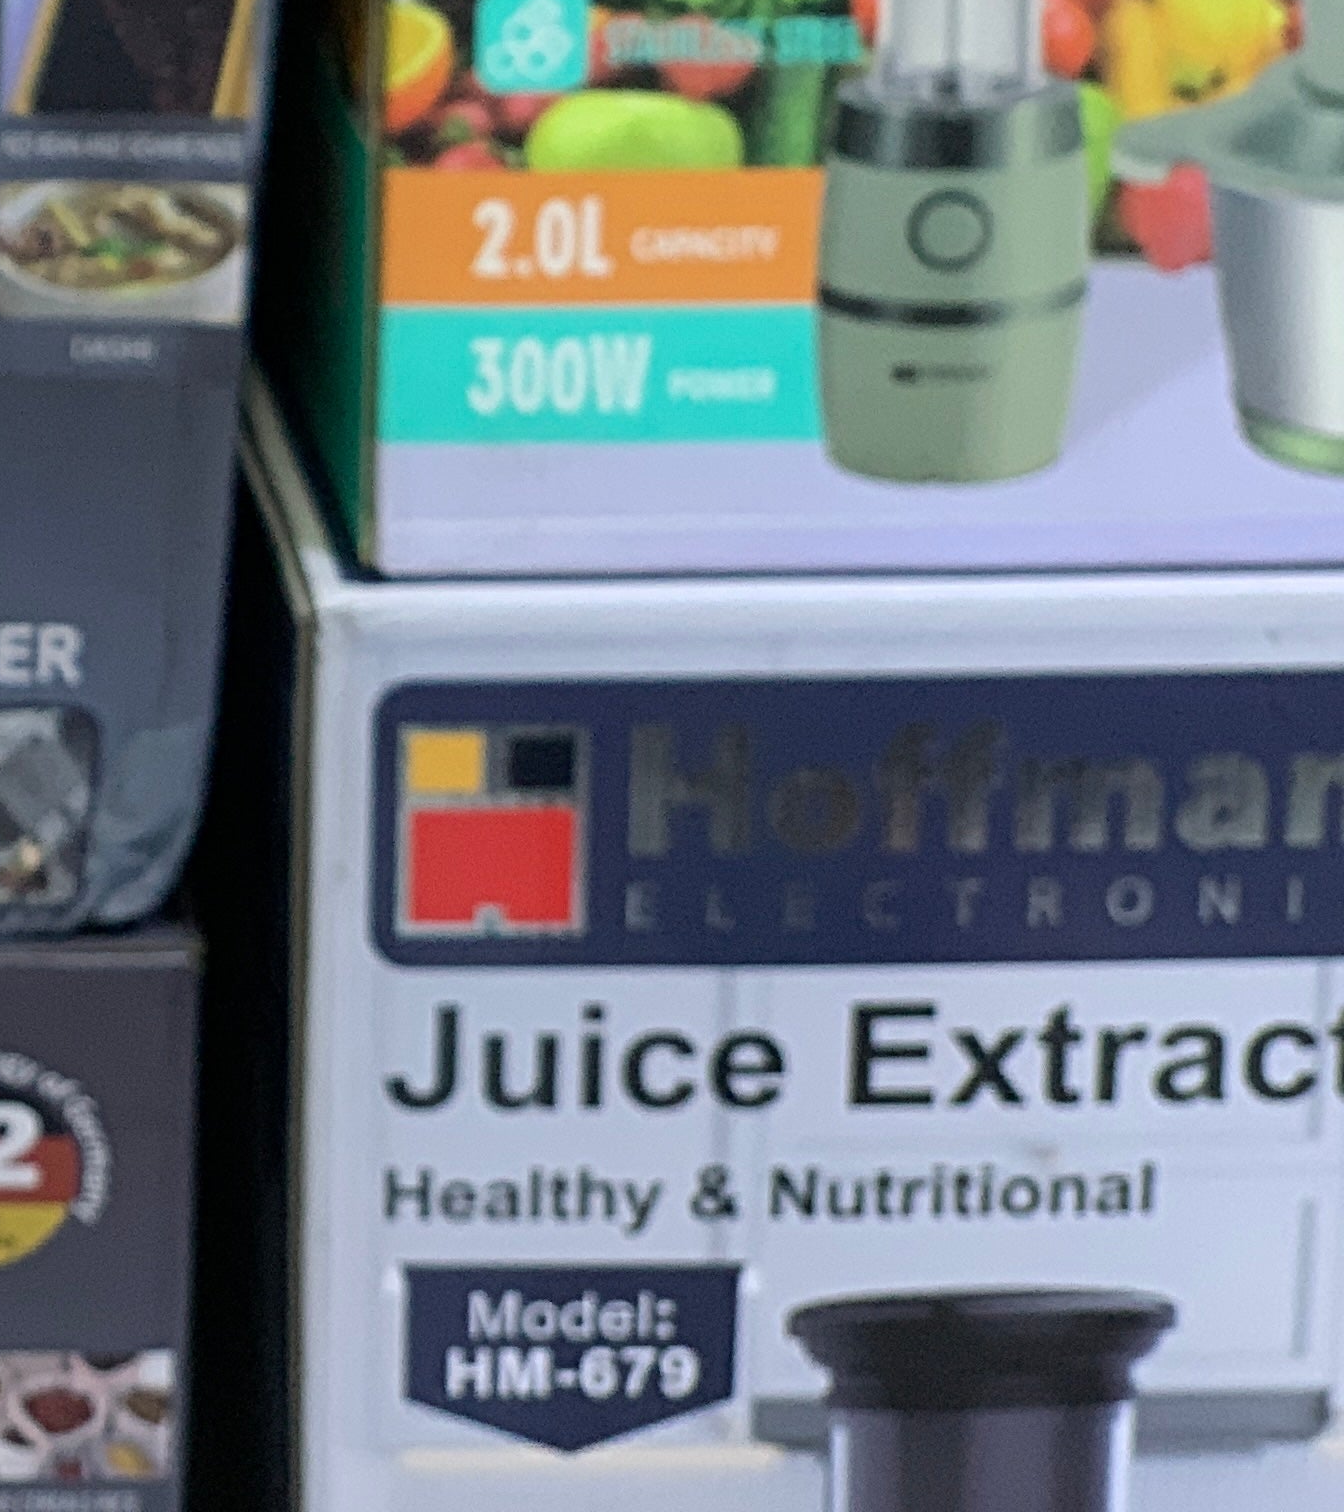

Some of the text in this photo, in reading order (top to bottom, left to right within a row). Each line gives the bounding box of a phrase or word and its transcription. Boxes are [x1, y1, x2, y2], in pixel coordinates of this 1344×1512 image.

[471, 195, 612, 280] 2.0L
[466, 334, 654, 416] 300W
[384, 999, 1344, 1111] Juice Extract
[382, 1161, 1158, 1236] Healthy & Nutritional
[468, 1289, 677, 1345] Model:
[445, 1346, 700, 1400] HM-679
